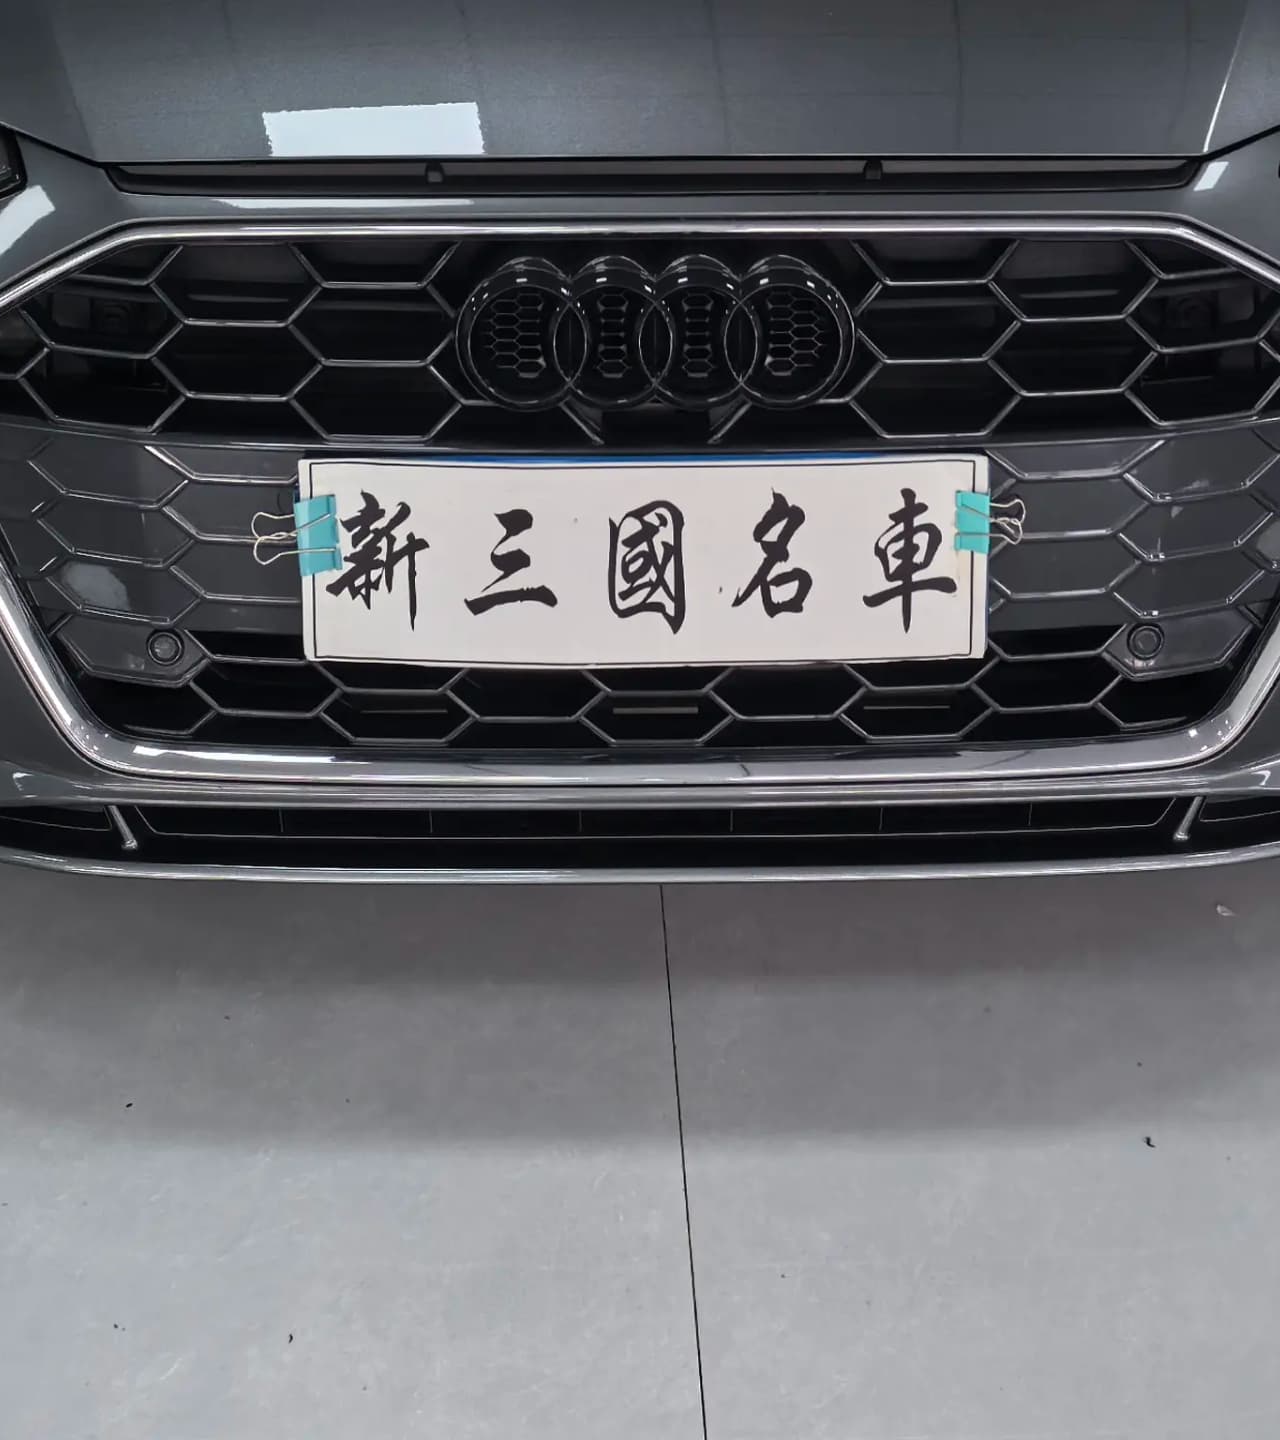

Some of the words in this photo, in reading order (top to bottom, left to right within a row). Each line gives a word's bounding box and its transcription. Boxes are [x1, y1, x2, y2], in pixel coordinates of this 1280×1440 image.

[326, 489, 957, 633] 新三國名車
